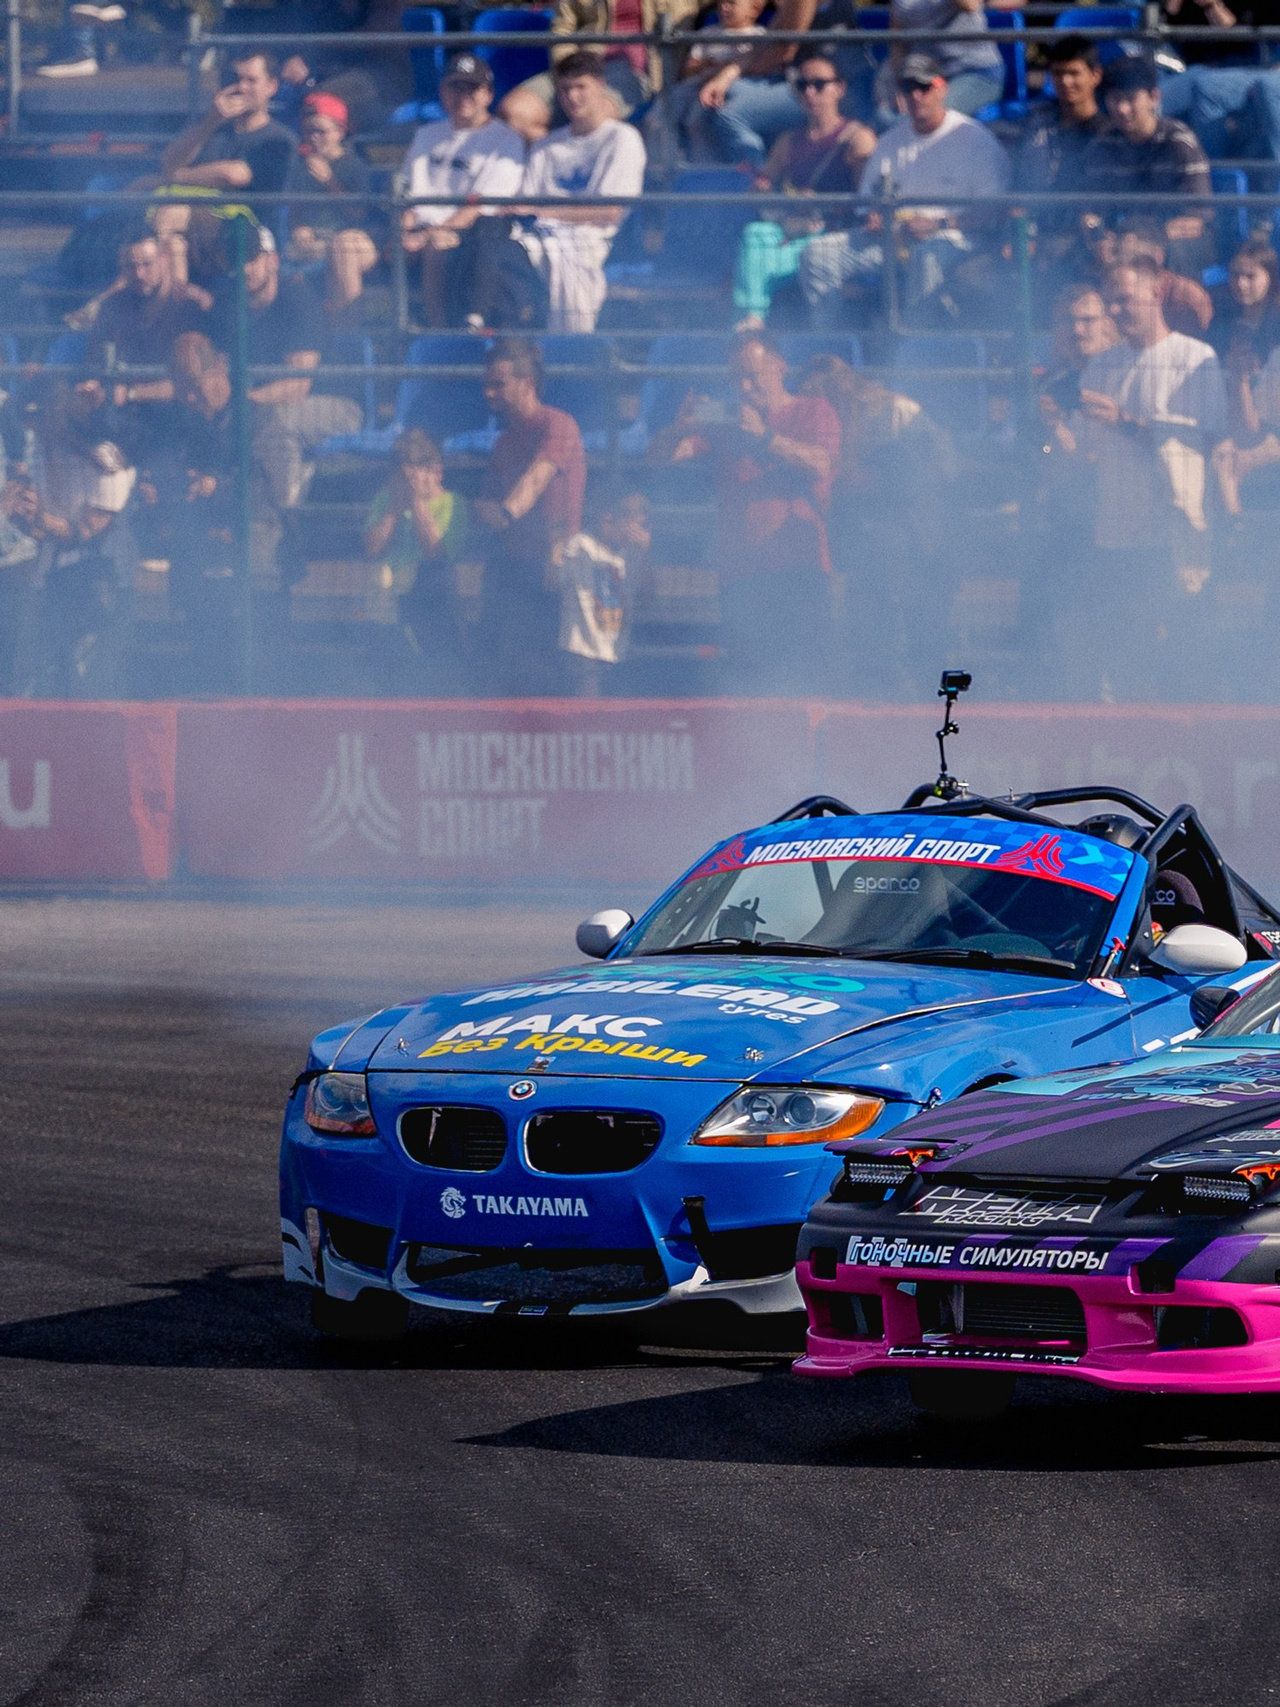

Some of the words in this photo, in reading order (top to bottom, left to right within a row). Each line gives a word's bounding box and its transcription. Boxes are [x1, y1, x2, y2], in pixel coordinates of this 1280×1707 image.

[744, 833, 916, 865] МОСКОВСКИЙ
[914, 838, 1001, 865] СПОРТ
[853, 875, 920, 893] sparco
[437, 1013, 663, 1042] МАКС
[717, 1002, 808, 1025] tyres
[417, 1034, 509, 1059] Без
[513, 1032, 710, 1068] Крыши
[471, 1194, 590, 1218] TAKAYAMA
[850, 1240, 955, 1265] ГОНОЧНЫЕ
[958, 1245, 1110, 1270] СИМУЛЯТОРЫ
